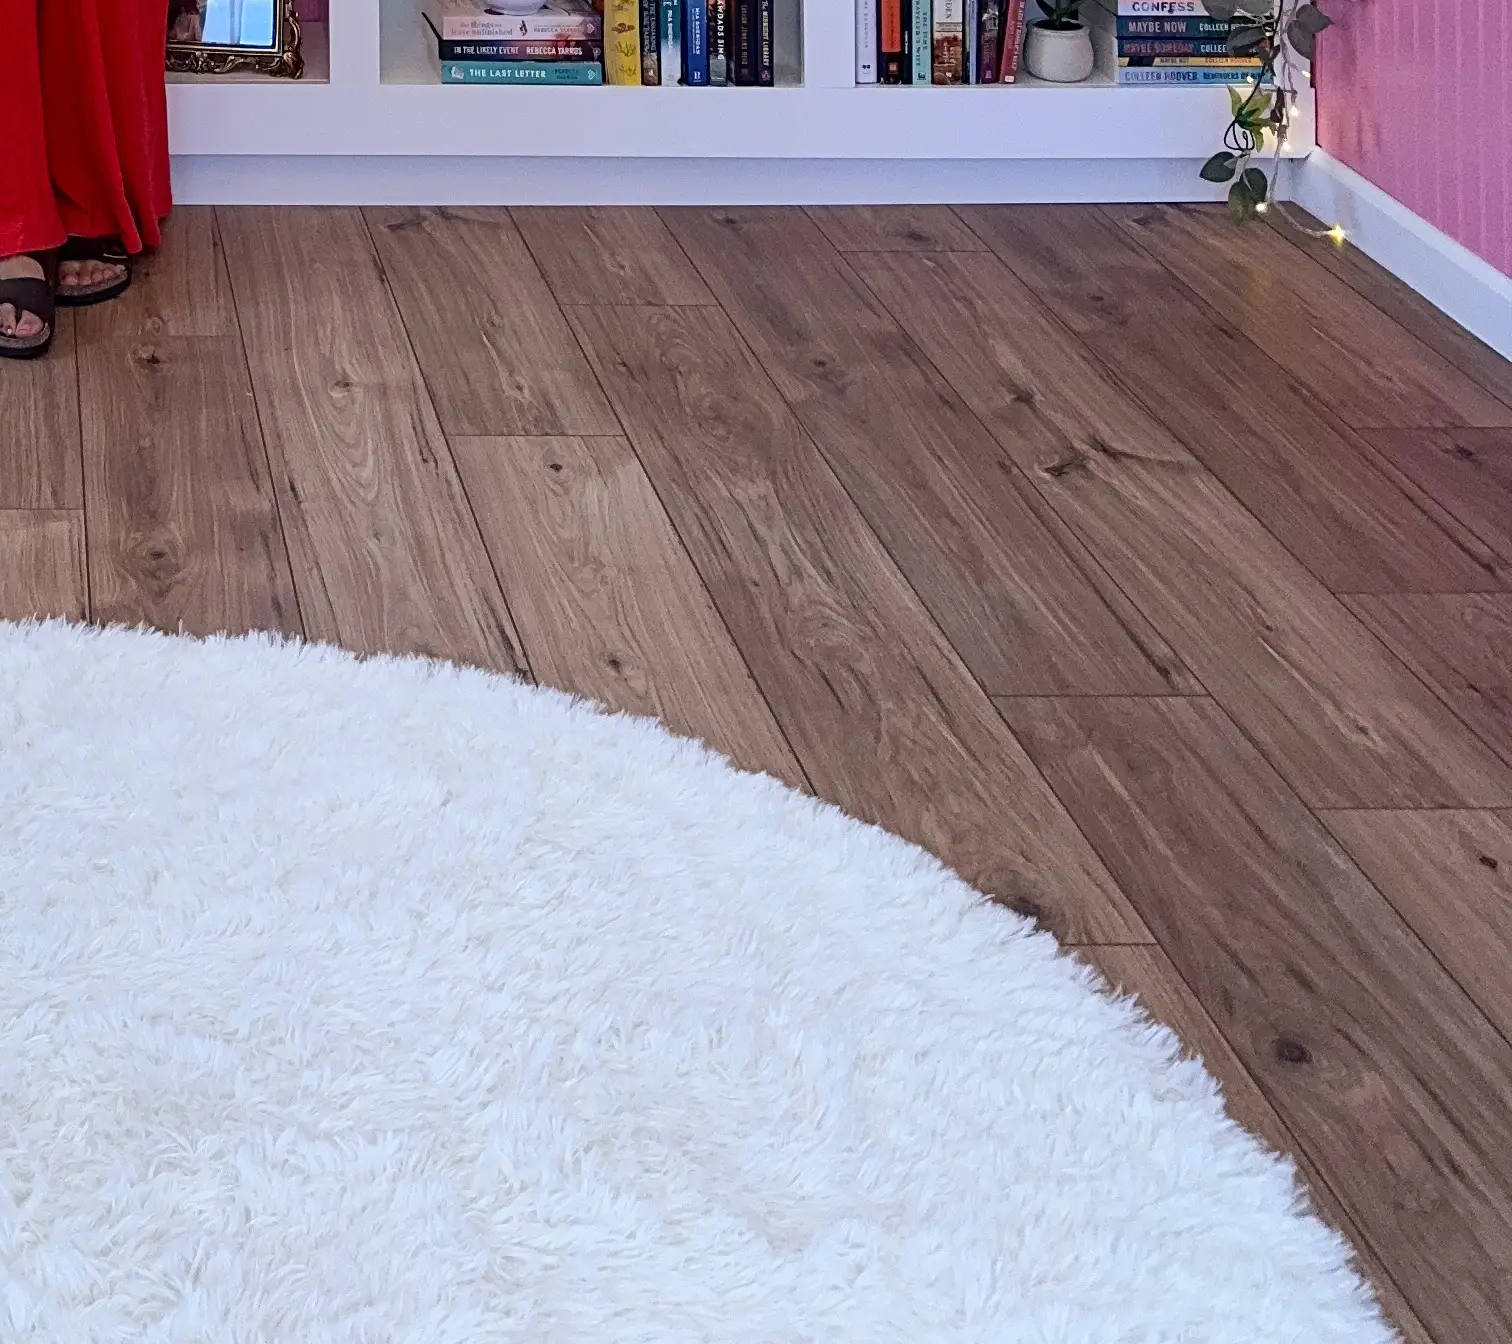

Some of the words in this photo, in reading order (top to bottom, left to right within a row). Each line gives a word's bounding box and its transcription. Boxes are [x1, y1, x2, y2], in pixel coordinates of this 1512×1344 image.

[1127, 21, 1161, 32] MAYBE
[1164, 21, 1187, 32] NOW
[469, 69, 486, 77] THE
[489, 69, 512, 78] LAST
[514, 69, 547, 78] LETTER
